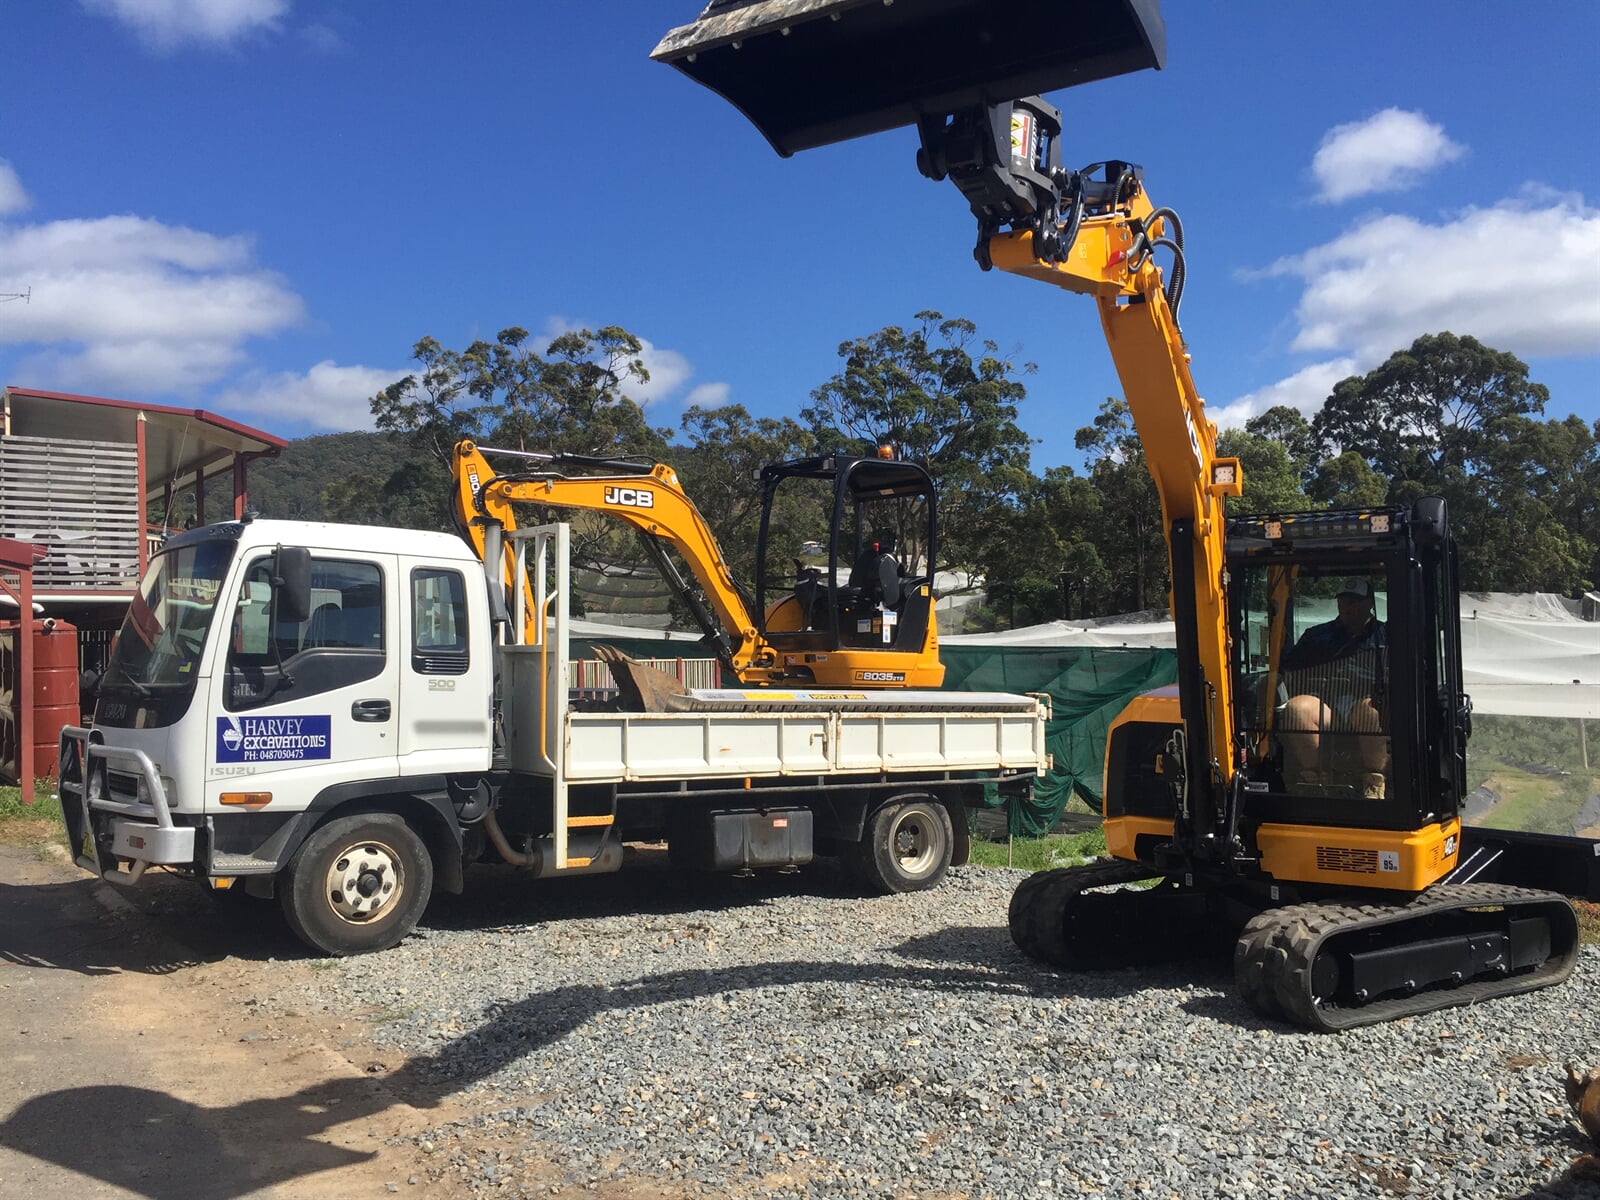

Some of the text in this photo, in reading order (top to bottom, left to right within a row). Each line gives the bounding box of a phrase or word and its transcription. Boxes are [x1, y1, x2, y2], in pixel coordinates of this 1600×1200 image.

[604, 487, 653, 508] JCB
[428, 679, 455, 688] 500
[245, 718, 304, 736] HARVEY
[243, 734, 326, 750] EXCAVATIONS
[244, 749, 304, 761] PH: 0487050475
[210, 766, 256, 776] ISUZU
[1383, 860, 1393, 870] 95
